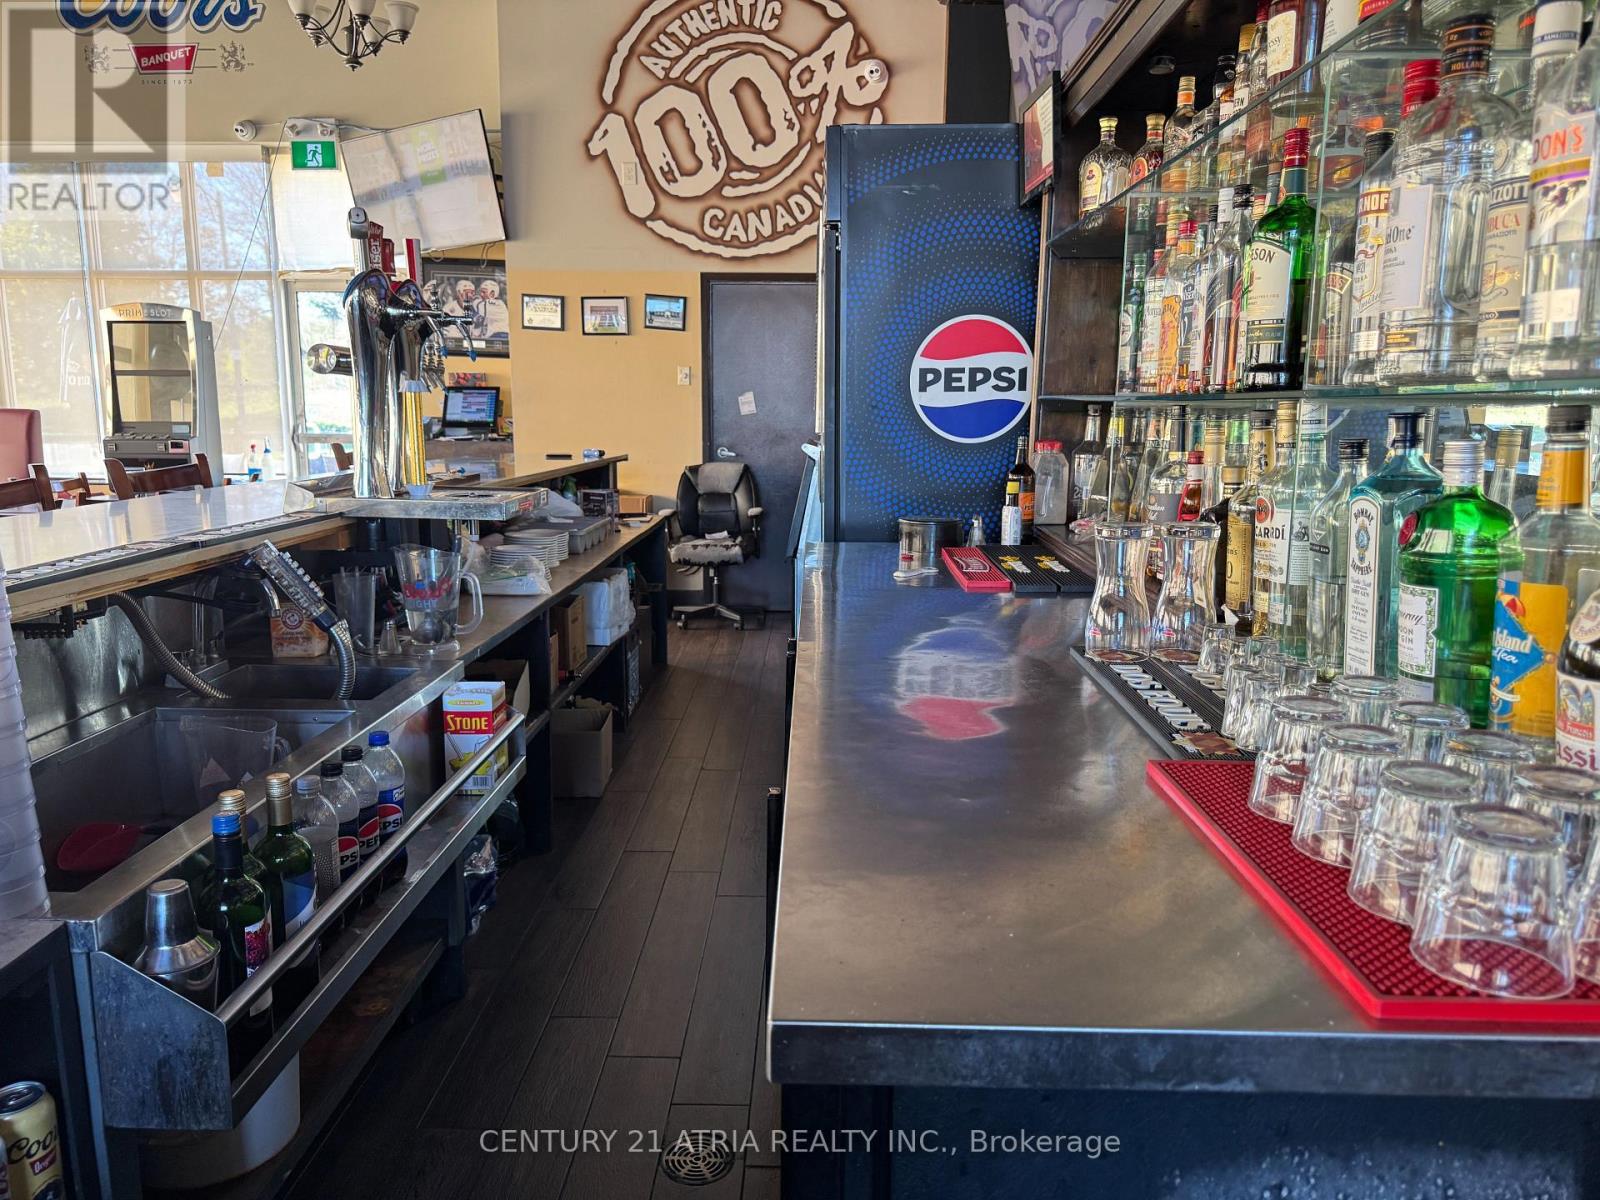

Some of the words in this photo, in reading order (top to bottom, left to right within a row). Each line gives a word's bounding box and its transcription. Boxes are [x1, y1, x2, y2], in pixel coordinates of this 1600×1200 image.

[639, 0, 783, 80] AUTHENTIC
[140, 46, 191, 68] BANQUET
[702, 171, 824, 242] CANADI
[918, 366, 1028, 393] PEPSI
[1494, 627, 1533, 654] Island
